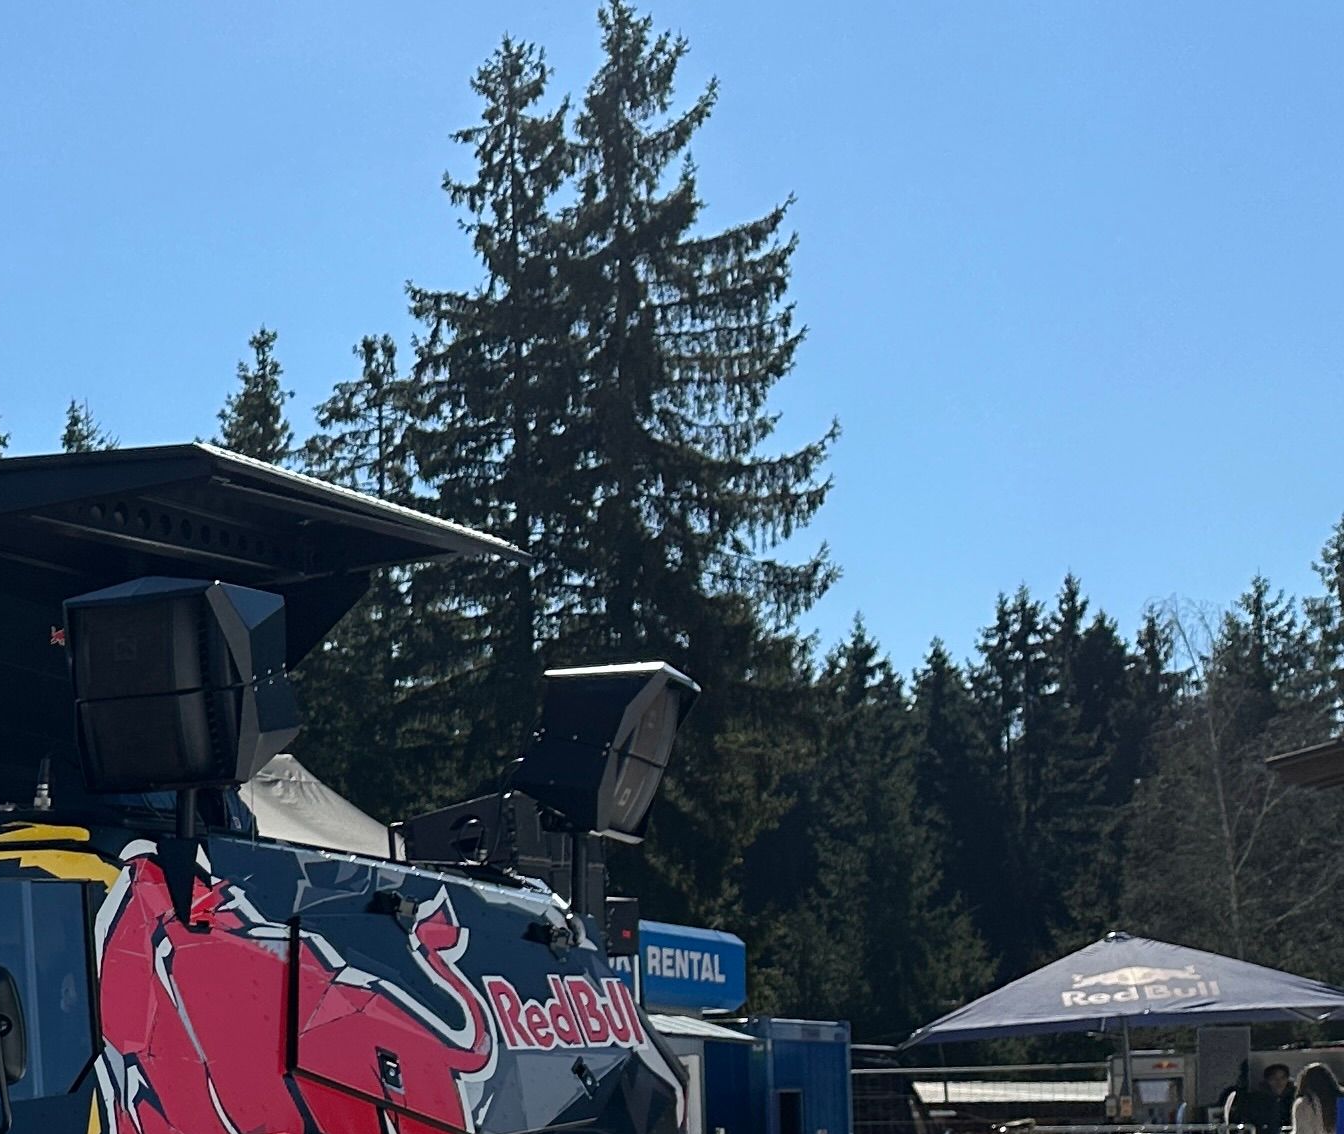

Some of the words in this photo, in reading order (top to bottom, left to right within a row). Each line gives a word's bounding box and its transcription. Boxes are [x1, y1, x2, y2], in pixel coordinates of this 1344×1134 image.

[647, 945, 726, 984] RENTAL
[1062, 986, 1139, 1007] Red
[1144, 981, 1221, 1000] Bull
